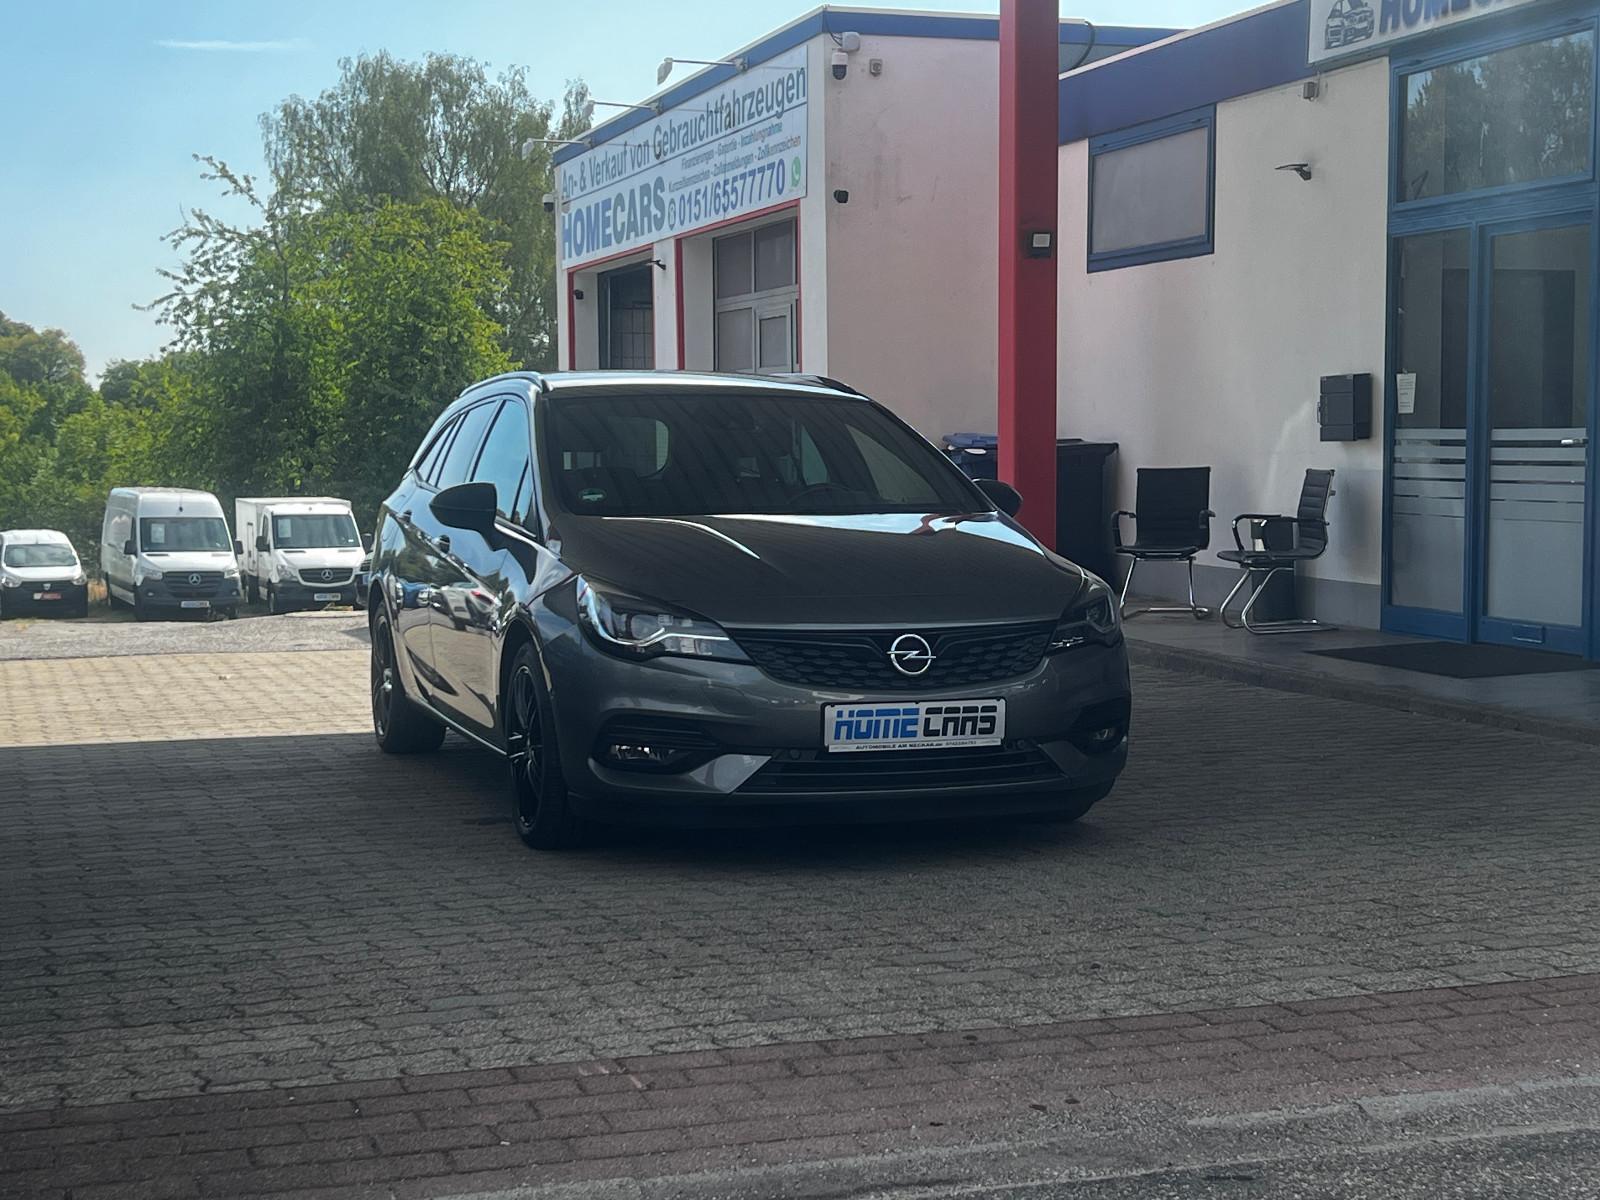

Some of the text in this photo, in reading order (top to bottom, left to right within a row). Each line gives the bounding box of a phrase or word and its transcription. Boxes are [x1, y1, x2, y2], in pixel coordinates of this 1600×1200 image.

[562, 67, 806, 199] An- & Verkauf von Gebrauchtfahrzeugen
[562, 176, 666, 260] HOMECARS
[678, 158, 786, 226] 0151/65577770
[834, 705, 998, 741] HOME CARS
